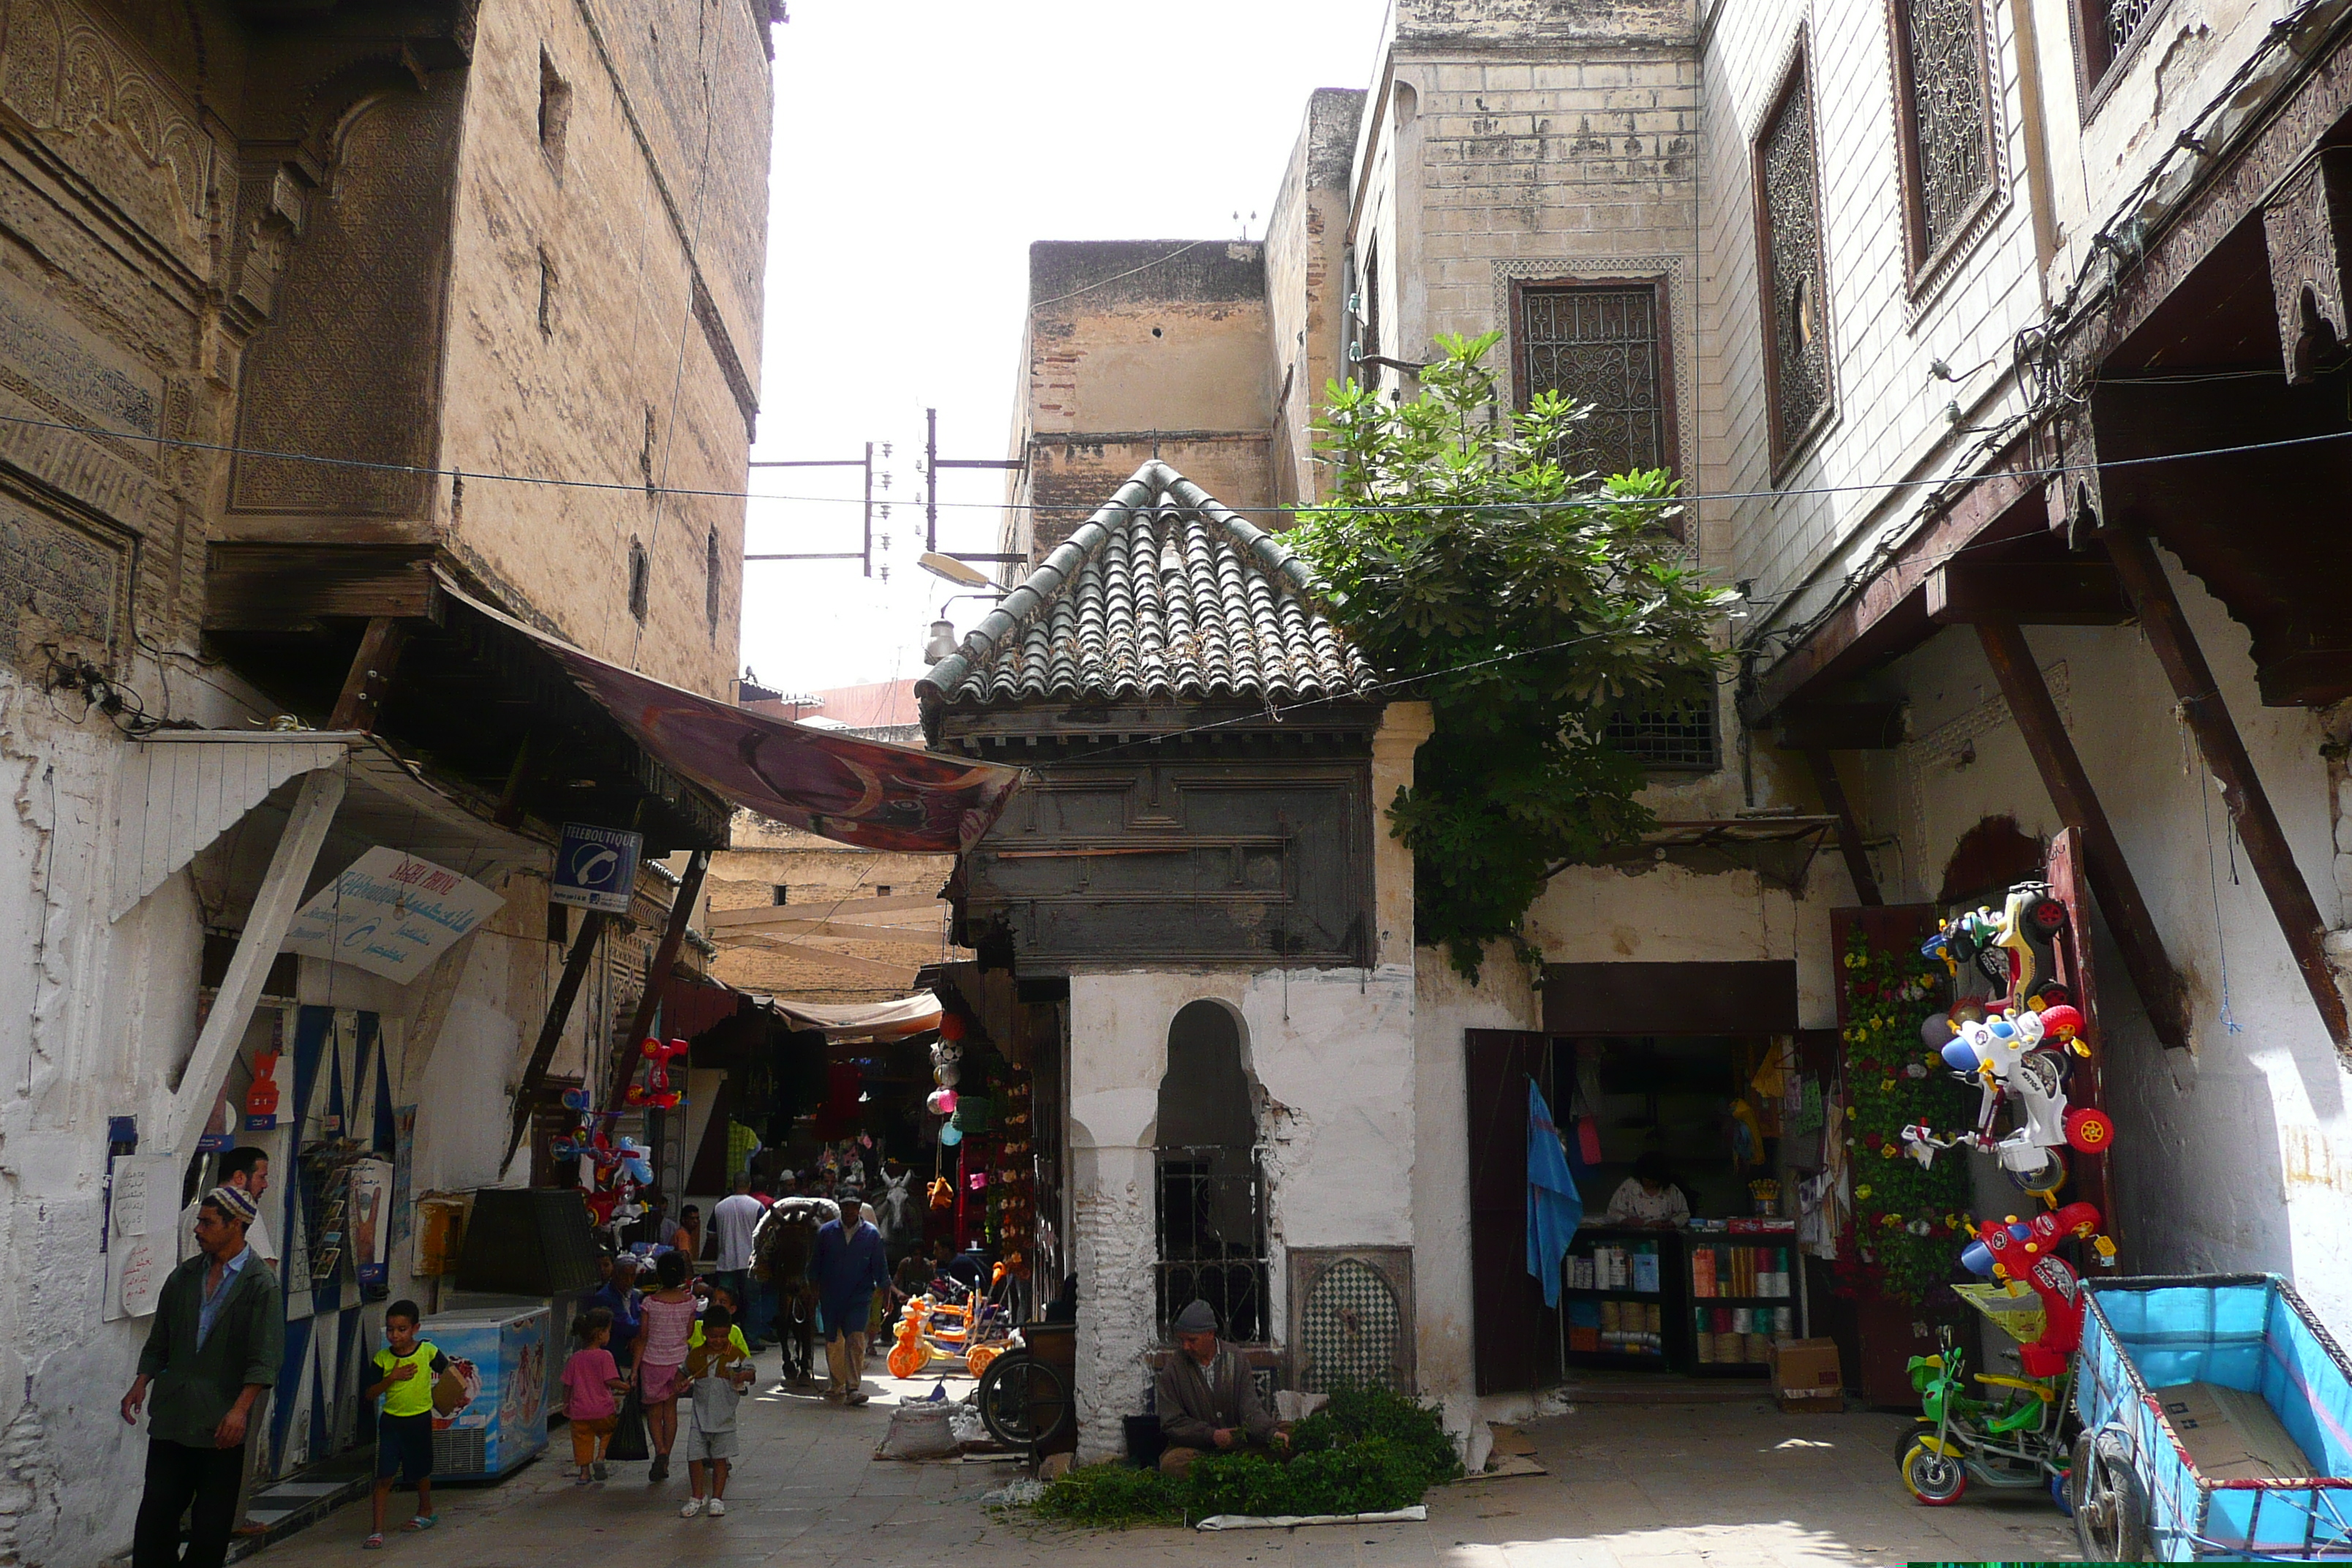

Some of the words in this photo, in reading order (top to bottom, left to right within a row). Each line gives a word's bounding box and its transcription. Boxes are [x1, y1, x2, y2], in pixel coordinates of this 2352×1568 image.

[418, 870, 461, 896] PHONE
[1981, 954, 1997, 974] POLICE
[2021, 1071, 2041, 1091] POLICE
[2033, 1267, 2054, 1288] POLICE
